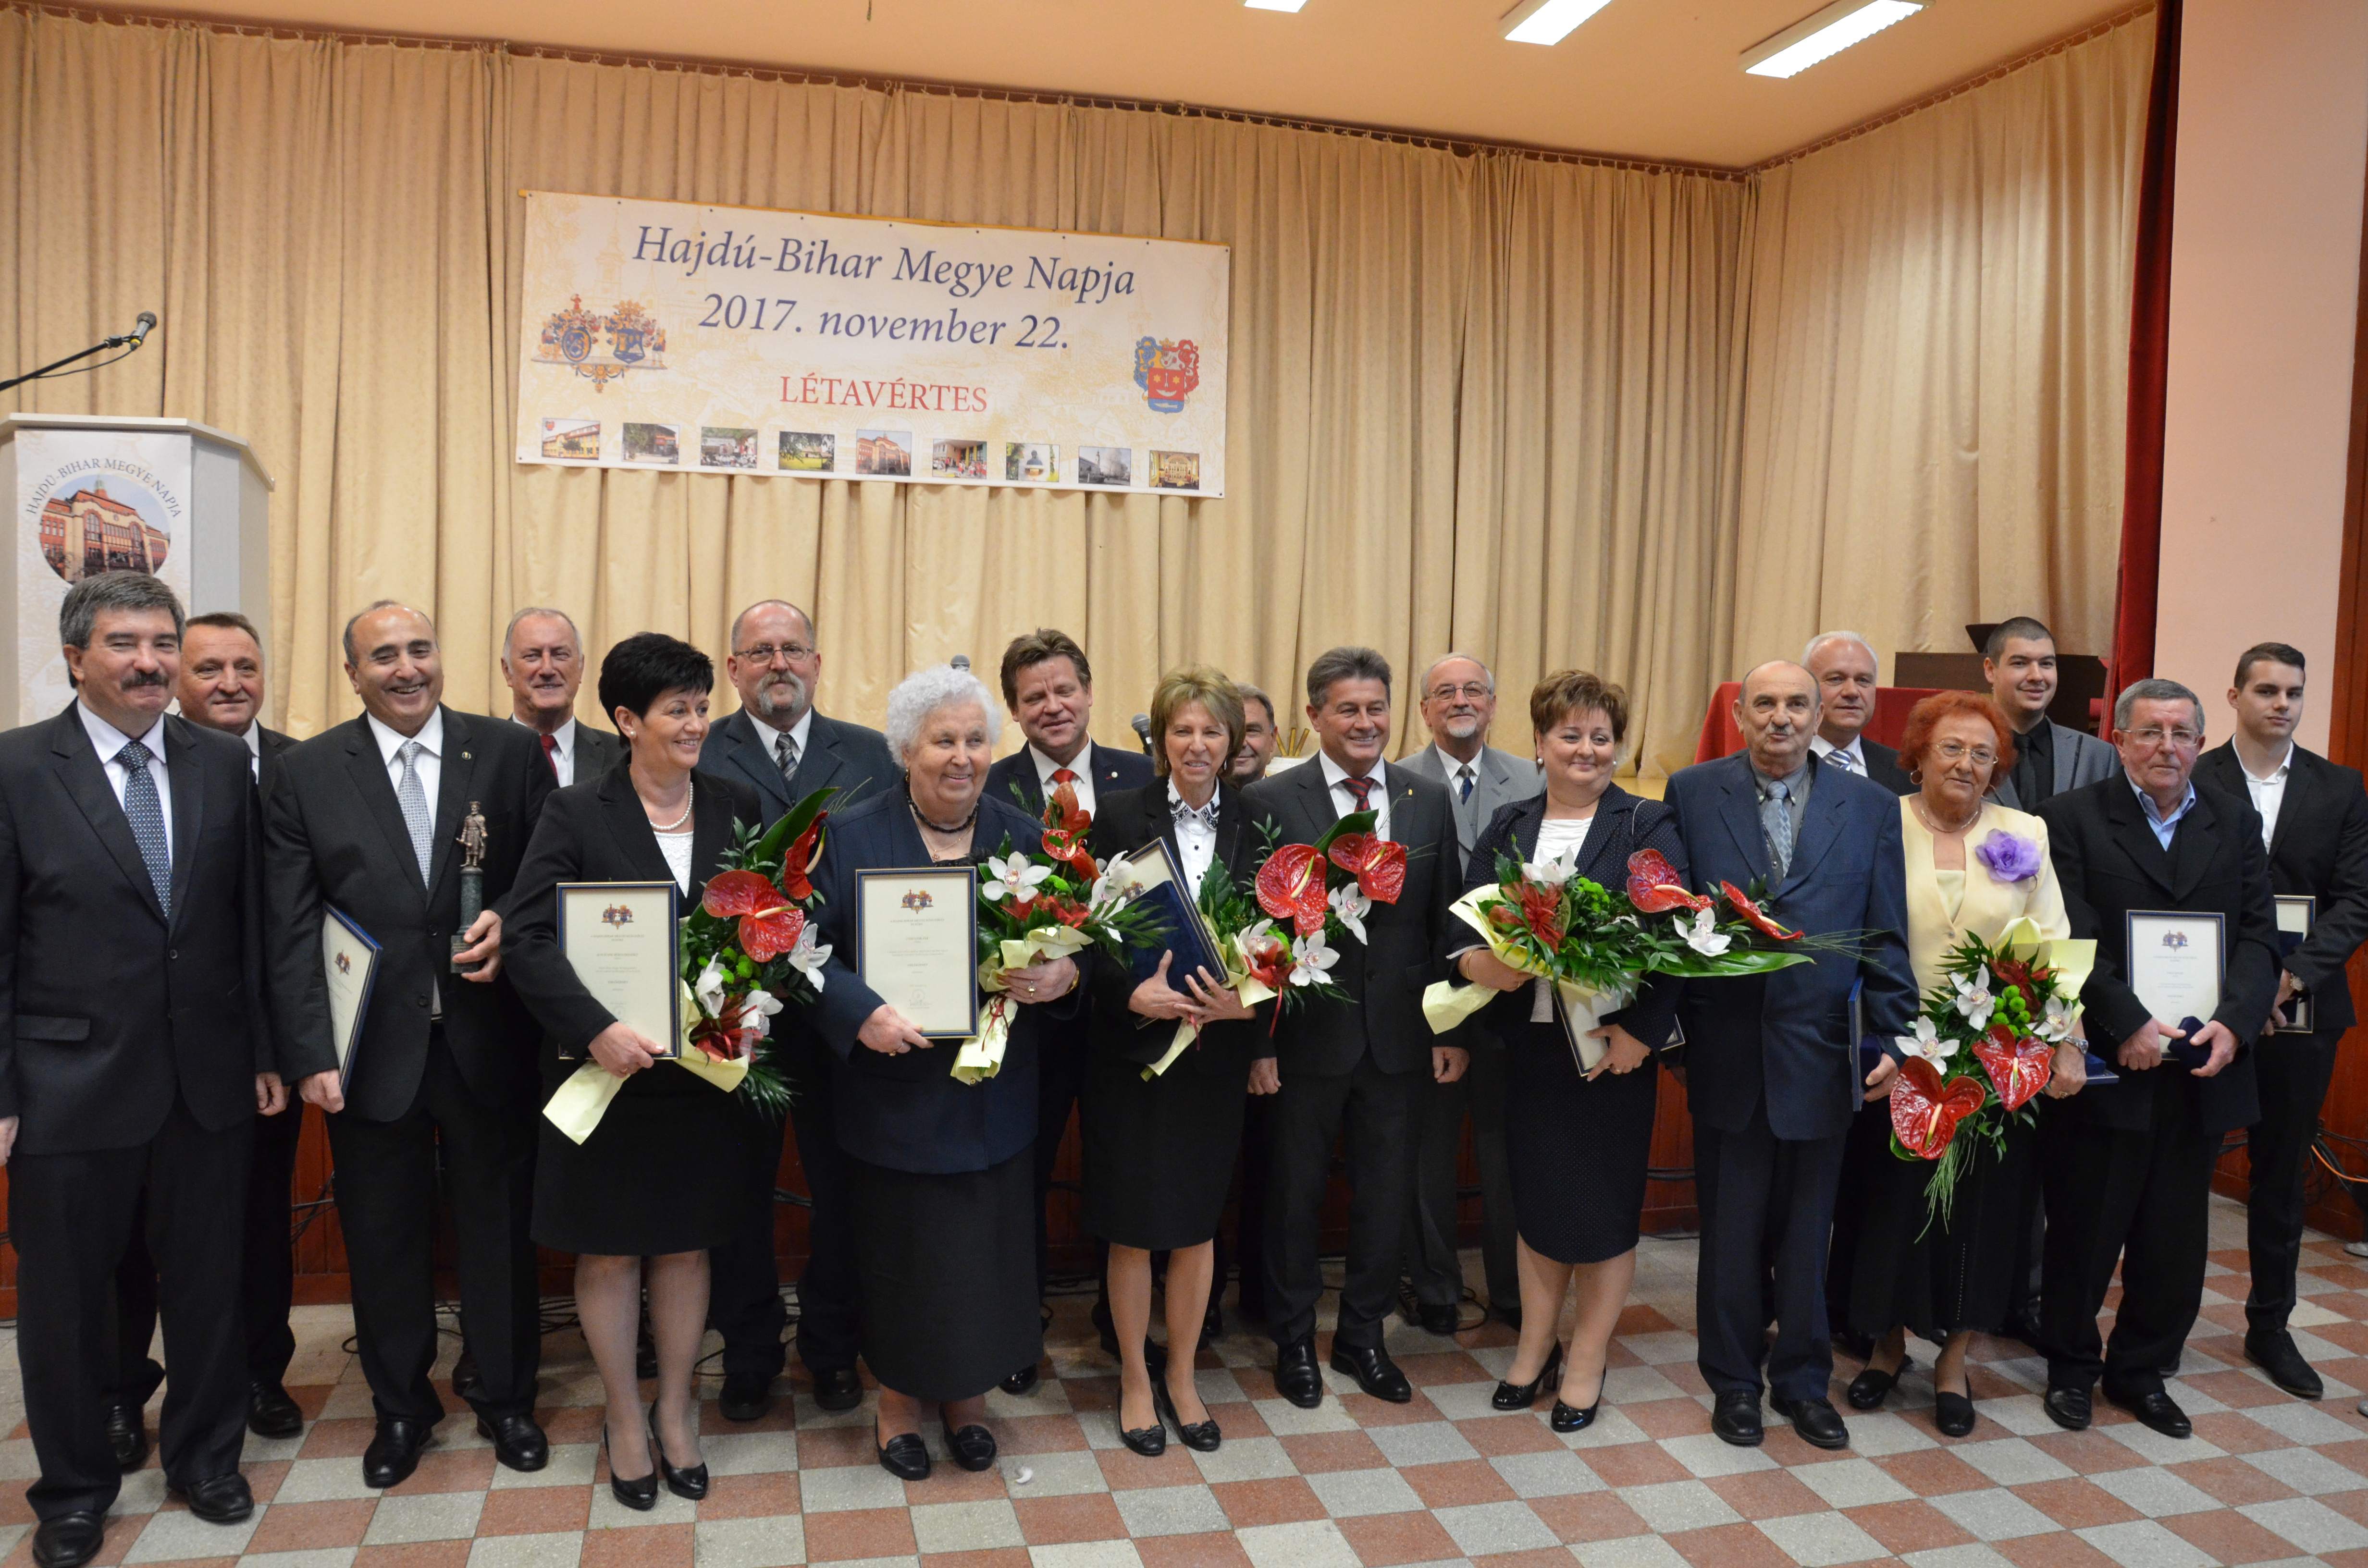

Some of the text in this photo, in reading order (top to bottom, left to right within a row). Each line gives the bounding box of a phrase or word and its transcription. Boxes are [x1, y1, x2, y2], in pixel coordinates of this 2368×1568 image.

[632, 225, 1135, 305] Hajdú-Bihar Megye Napja
[698, 293, 1068, 349] 2017. november 22.
[779, 372, 988, 412] LÉTAVÉRTES
[104, 458, 153, 483] MEGYE
[151, 479, 182, 518] NAPJA
